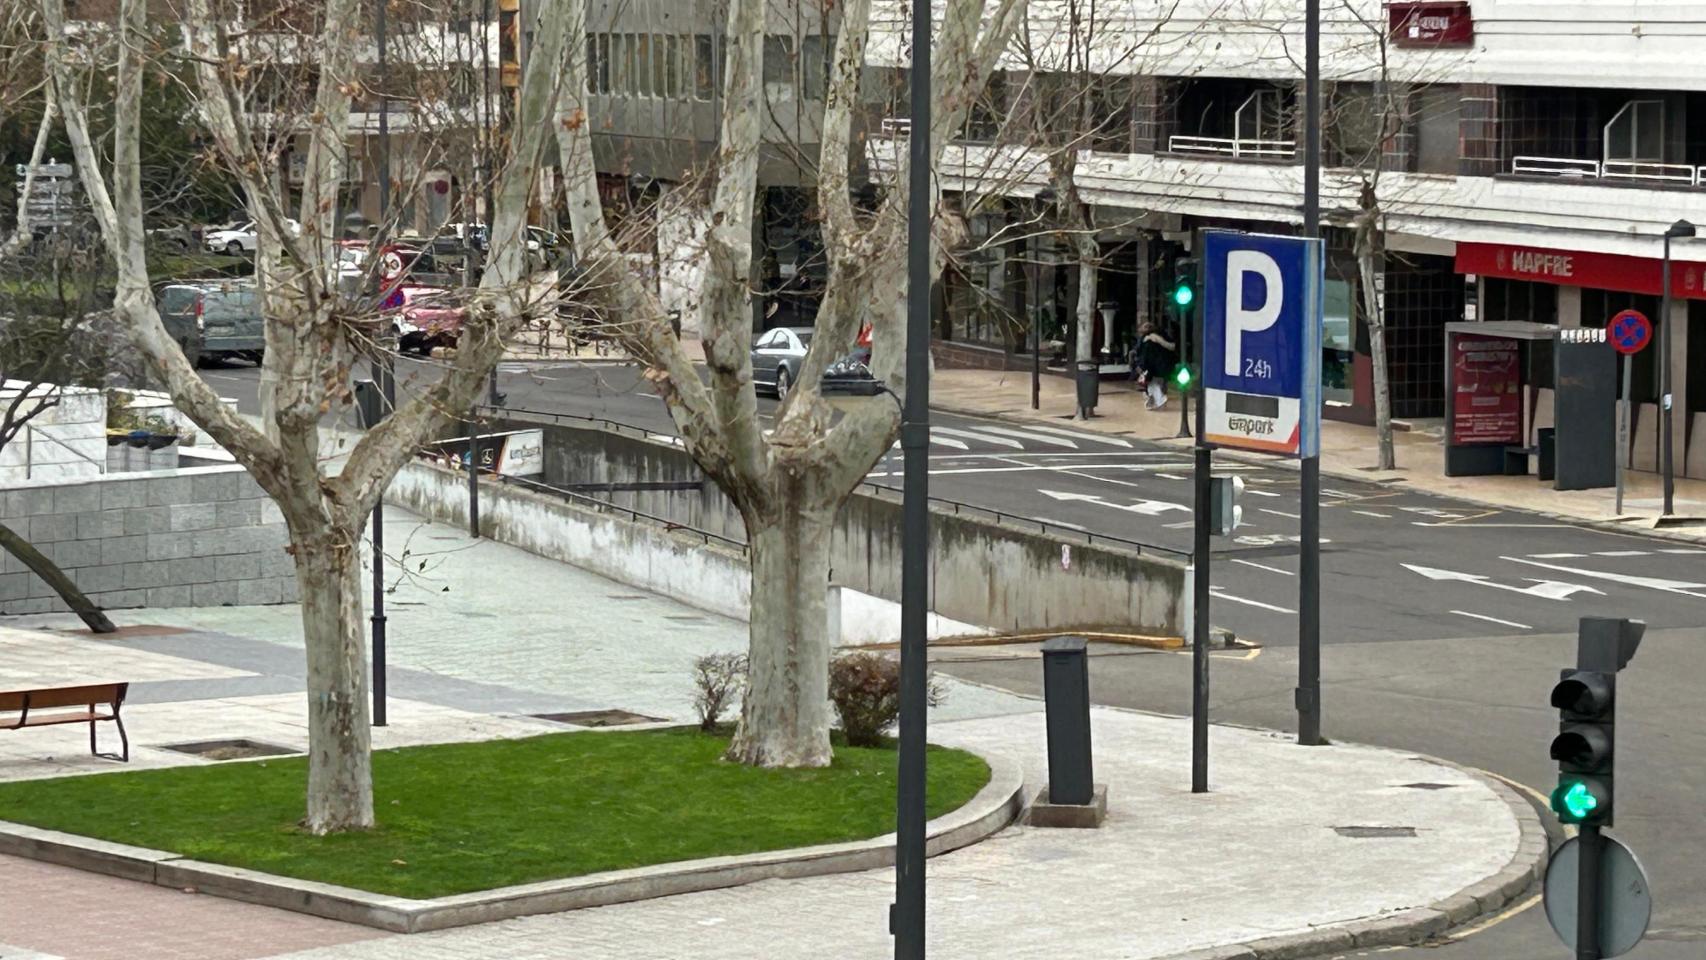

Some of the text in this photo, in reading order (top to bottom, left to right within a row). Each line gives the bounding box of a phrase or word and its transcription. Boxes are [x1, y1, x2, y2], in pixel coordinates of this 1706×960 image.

[1512, 250, 1573, 277] MAPFRE
[1225, 250, 1284, 376] P
[1245, 358, 1271, 379] 24h
